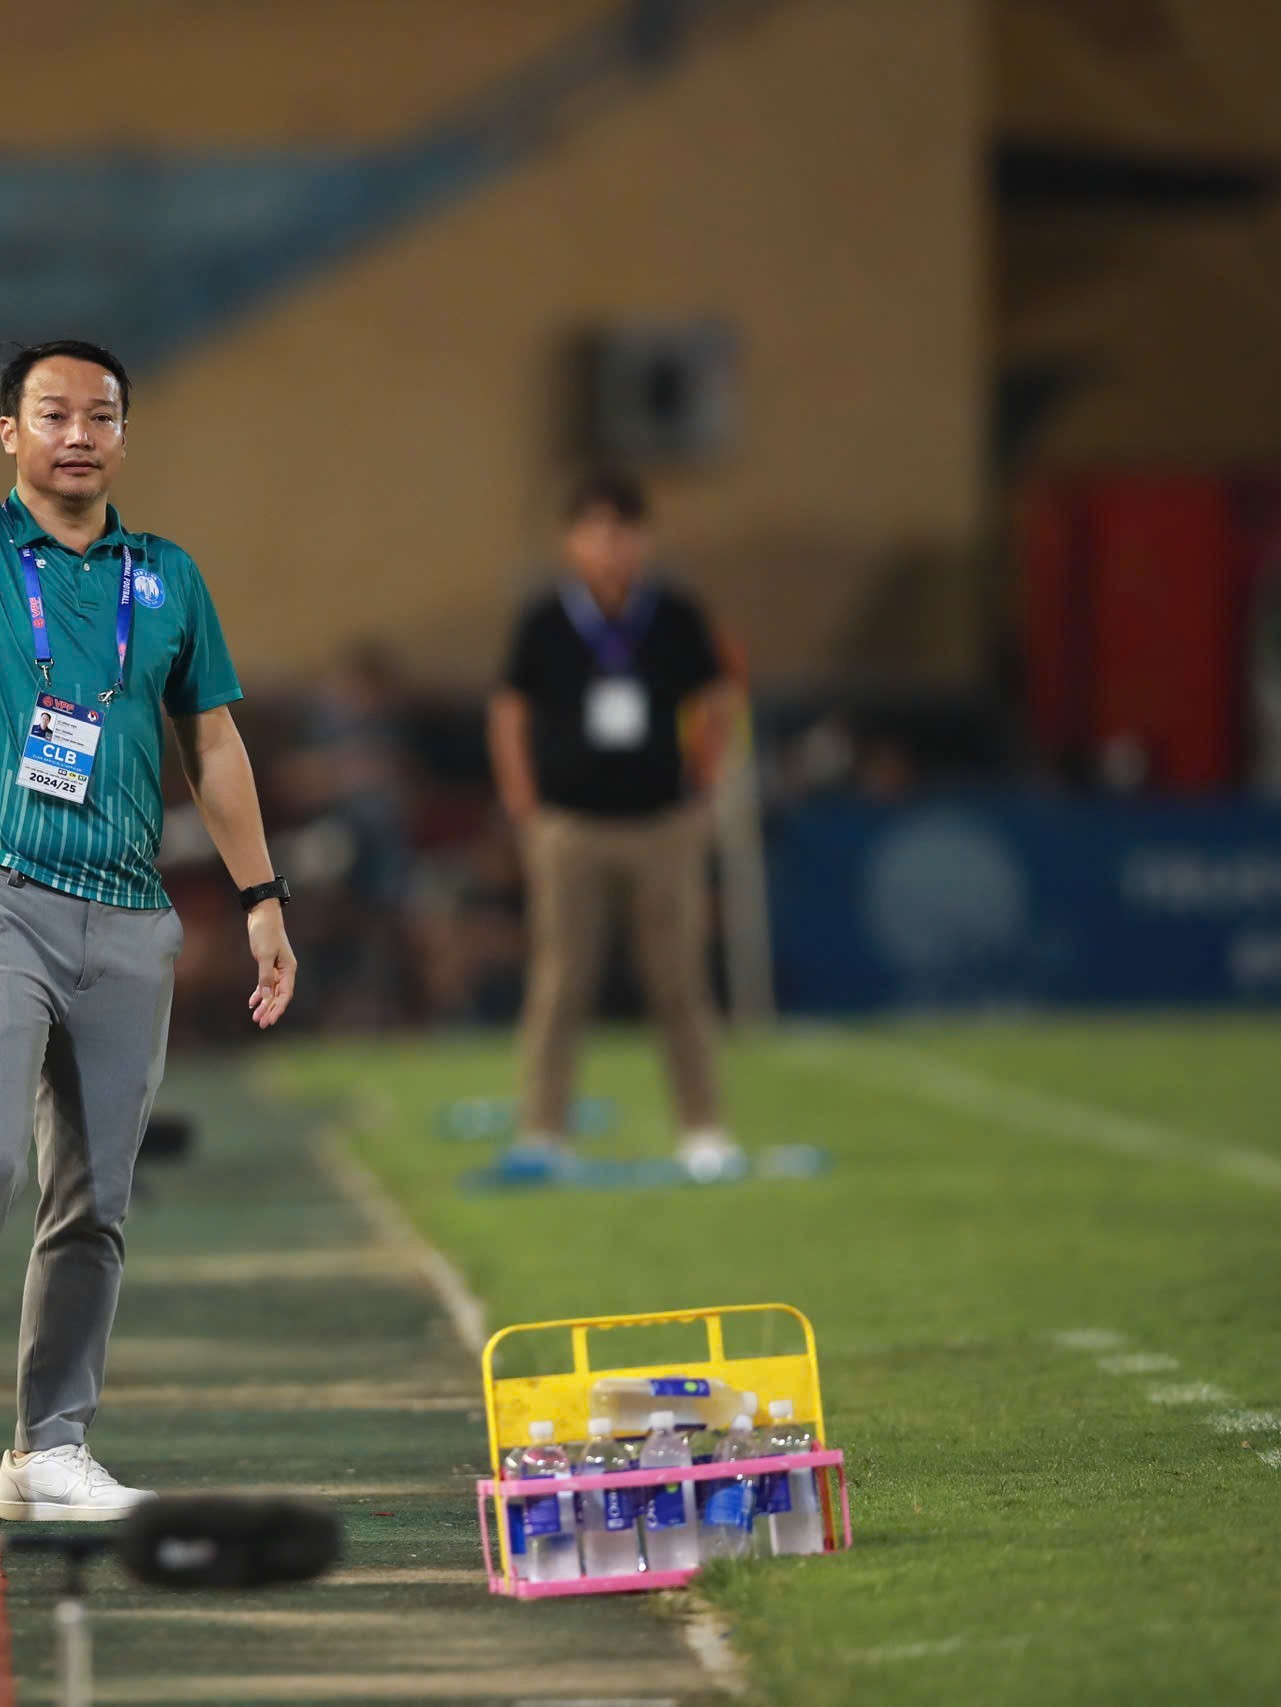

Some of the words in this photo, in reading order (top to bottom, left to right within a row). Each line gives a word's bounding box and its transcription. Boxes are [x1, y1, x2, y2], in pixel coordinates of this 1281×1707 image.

[121, 577, 131, 605] FOOTBALL
[29, 596, 41, 618] VPF
[54, 699, 75, 711] VPF
[43, 744, 77, 765] CLB
[29, 772, 77, 793] 2024/25
